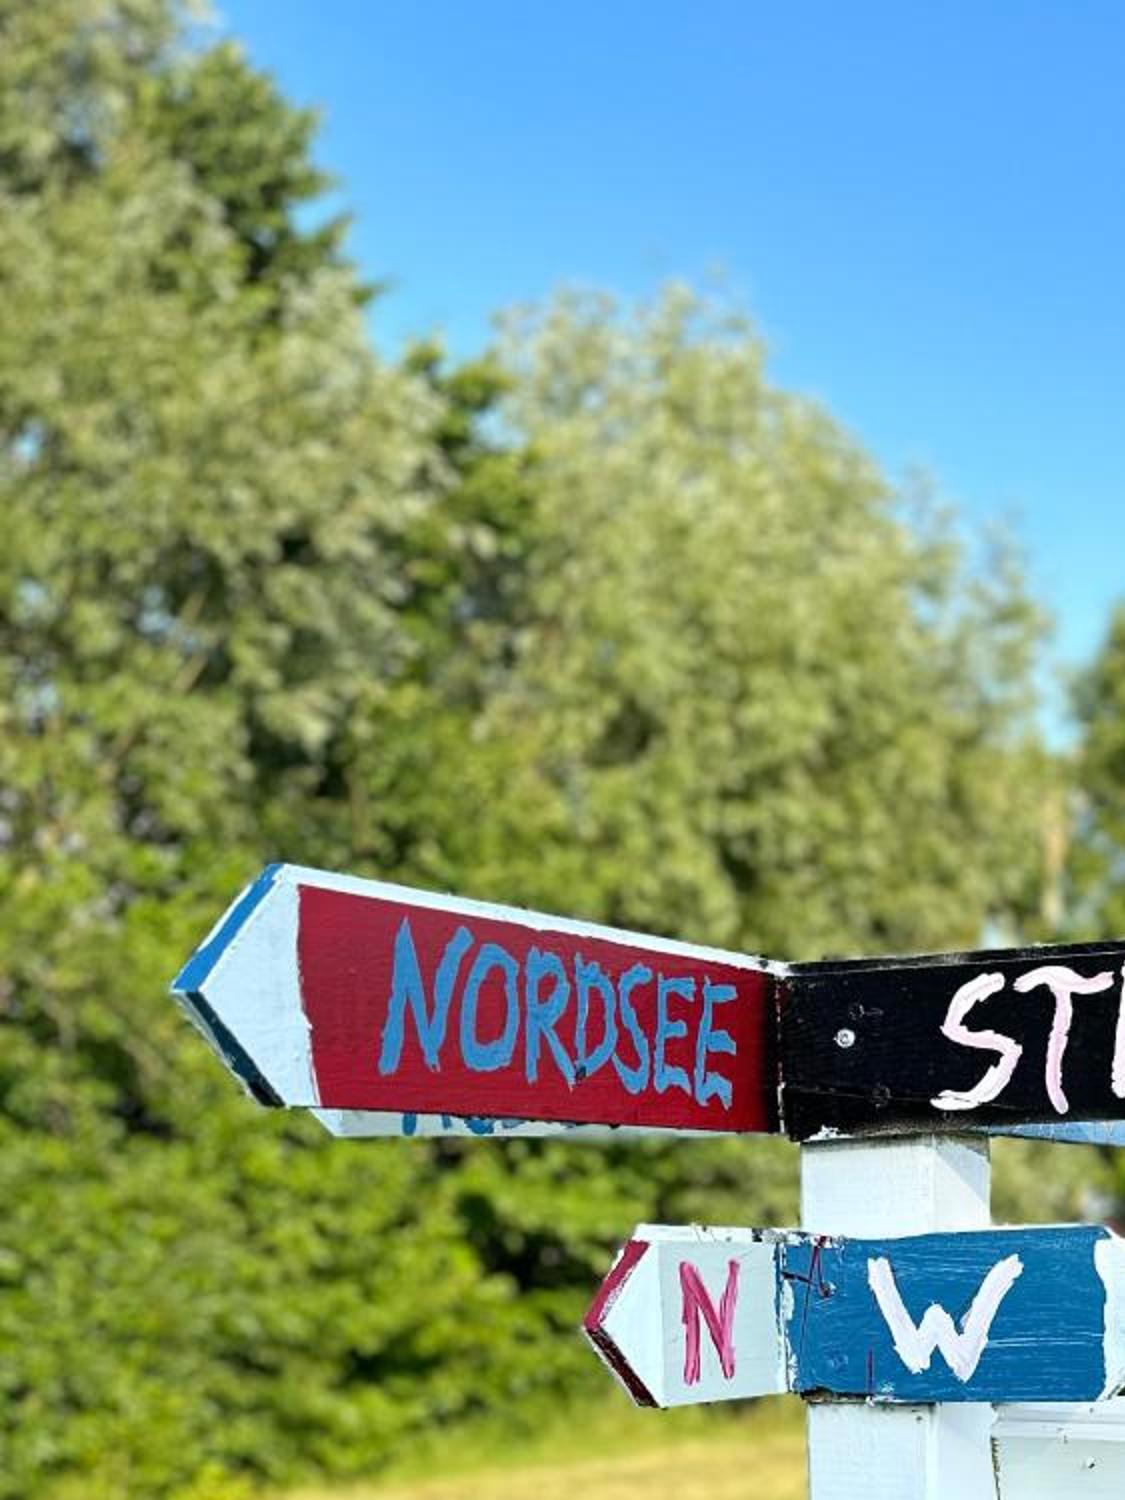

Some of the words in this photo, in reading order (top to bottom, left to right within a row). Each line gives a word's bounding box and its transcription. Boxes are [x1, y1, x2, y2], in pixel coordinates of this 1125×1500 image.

[378, 916, 738, 1111] NORDSEE
[679, 1259, 740, 1386] N
[867, 1253, 1024, 1383] W
